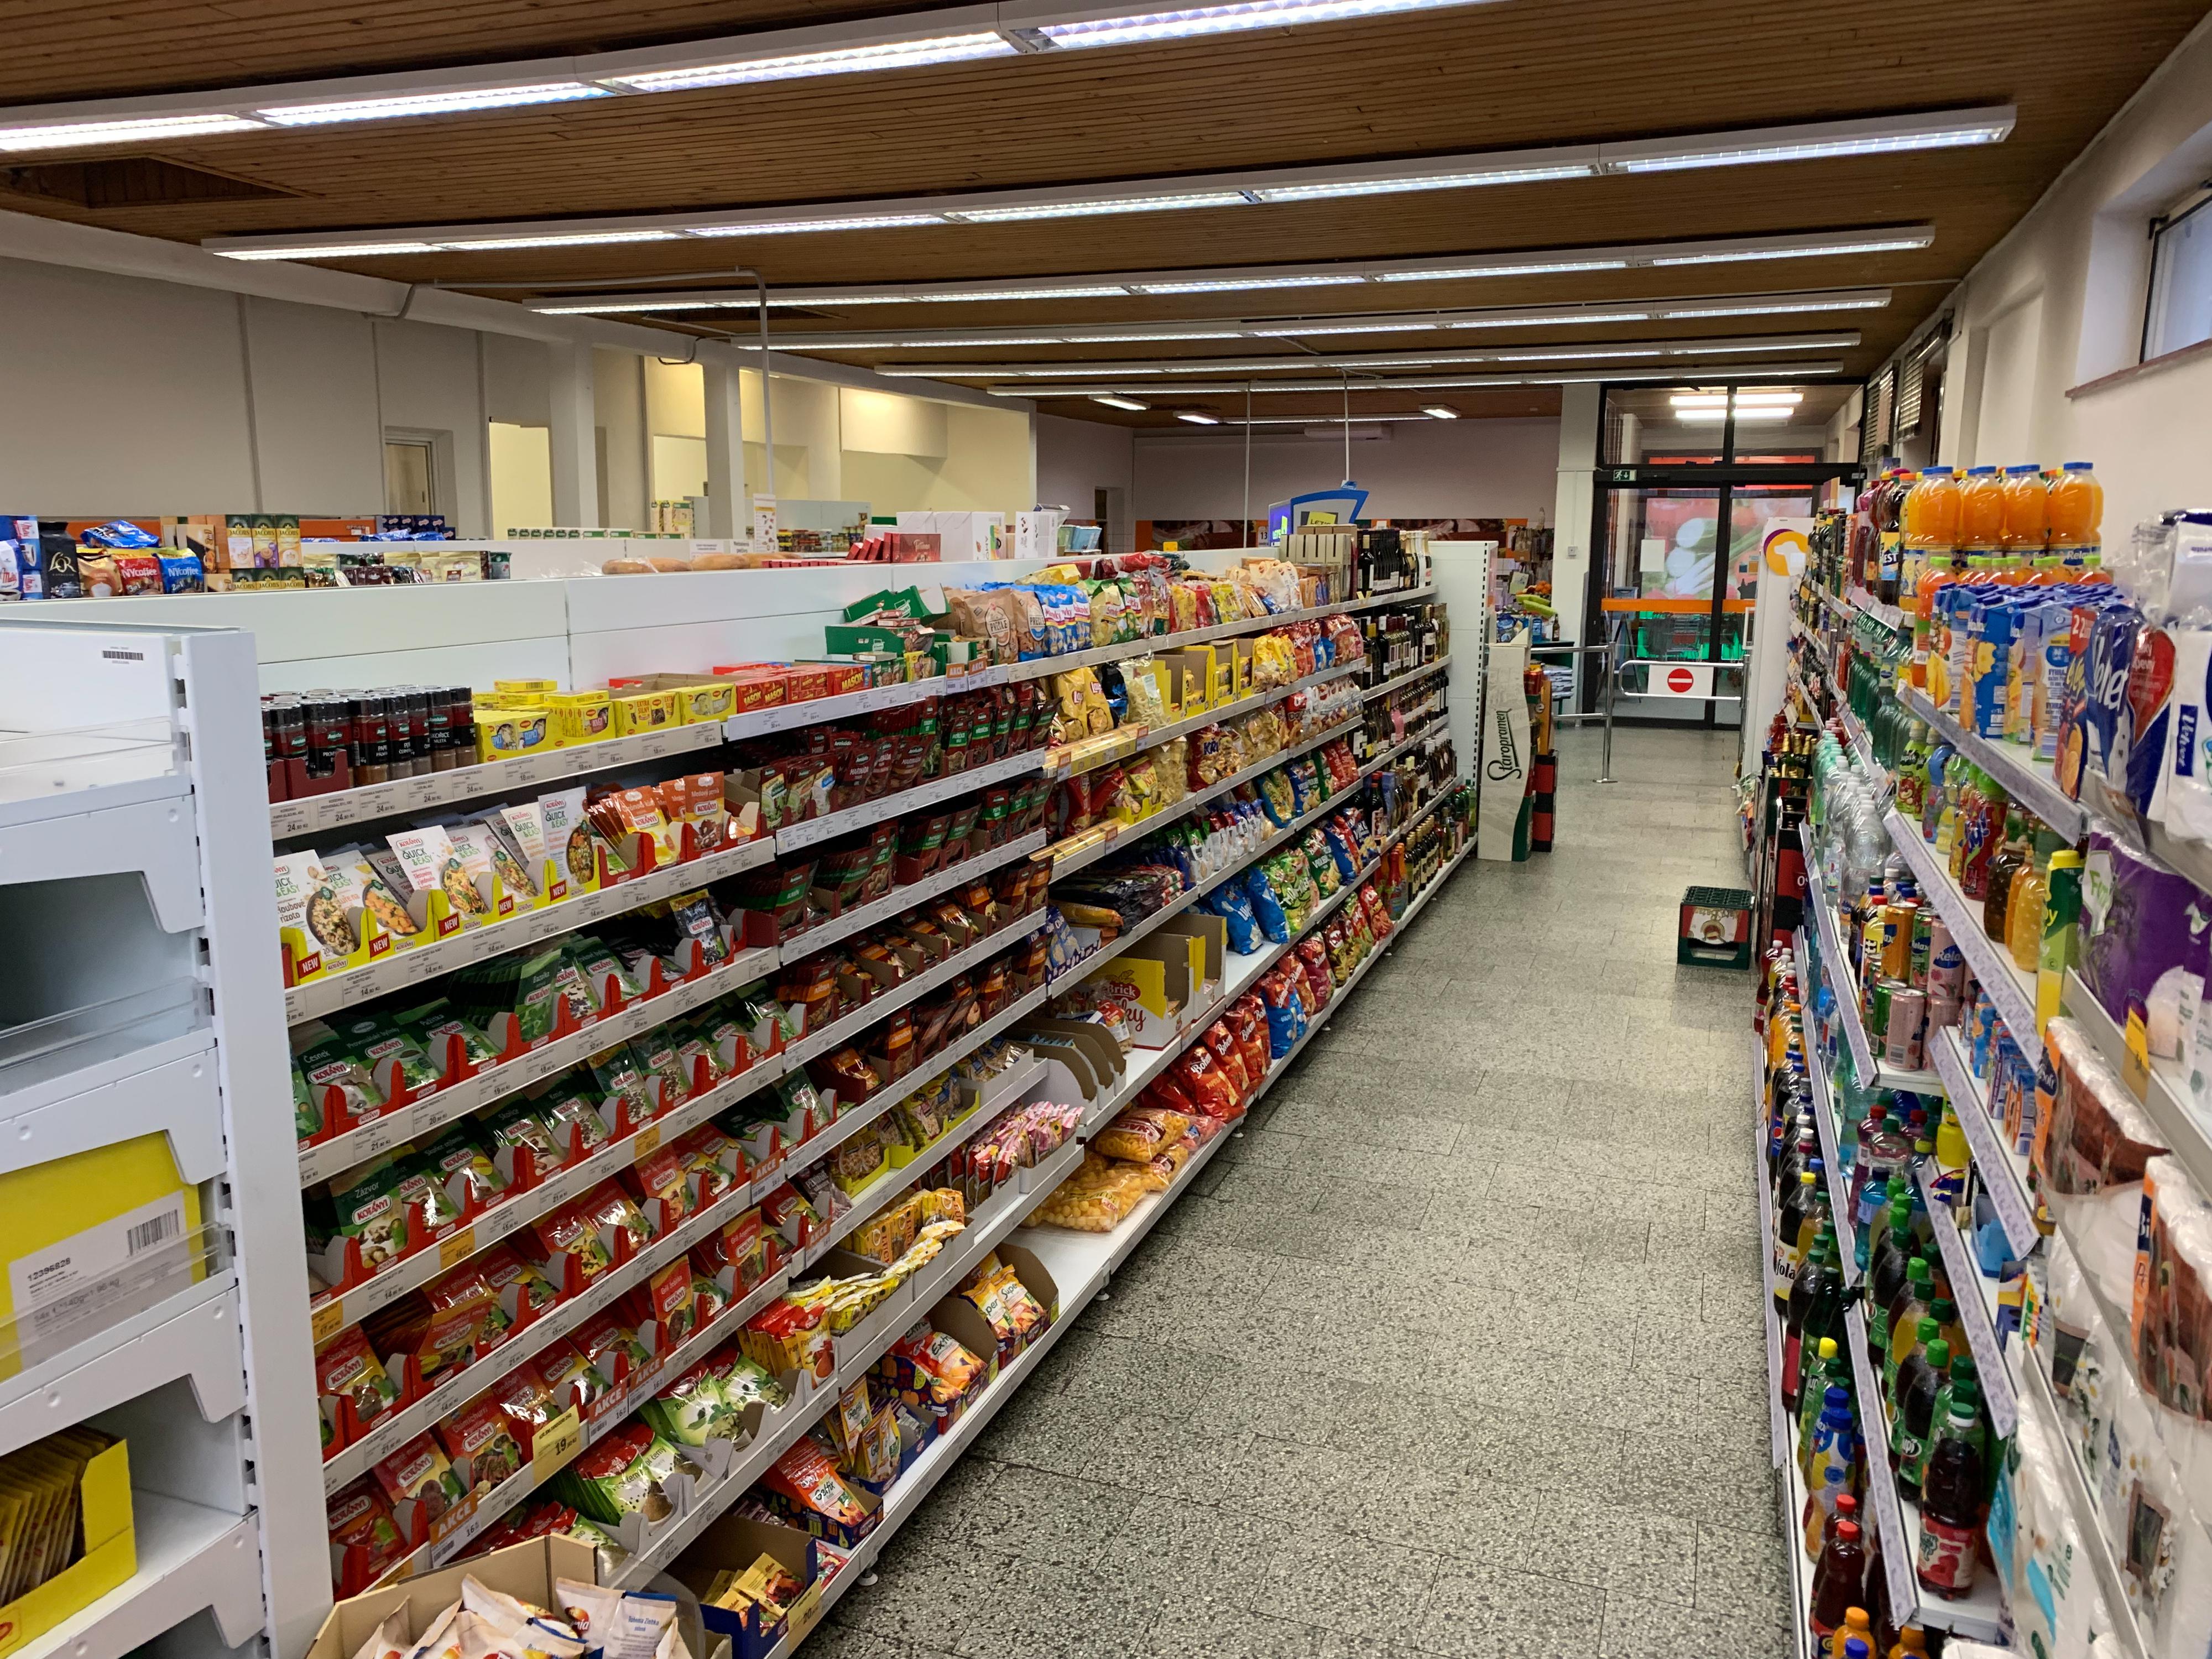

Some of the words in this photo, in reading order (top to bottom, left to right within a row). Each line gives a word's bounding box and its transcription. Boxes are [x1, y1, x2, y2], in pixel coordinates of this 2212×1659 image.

[1261, 531, 1267, 540] 13
[168, 567, 199, 577] NYcoffee
[842, 673, 863, 691] MASOX
[765, 687, 784, 703] MASOX
[1487, 708, 1522, 781] Staropramen
[696, 802, 717, 813] KOTÁNYI
[546, 811, 565, 823] QUICK
[634, 815, 658, 826] KOTÁNYI
[399, 838, 421, 847] KOTÁNYI
[403, 848, 427, 859] QUICK
[553, 884, 566, 896] NEW
[499, 899, 513, 912] NEW
[280, 912, 300, 924] rizoto
[444, 918, 458, 931] NEW
[373, 938, 388, 952] NEW
[1937, 951, 1963, 961] Rela
[302, 958, 319, 973] NEW
[591, 959, 614, 972] KOTÁNYI
[371, 1040, 402, 1056] KOTÁNYI
[680, 1041, 701, 1055] KOTÁNYI
[304, 1050, 331, 1063] Česnek
[651, 1051, 672, 1065] KOTÁNYI
[312, 1062, 347, 1081] KOTÁNYI
[444, 1150, 472, 1167] KOTÁNYI
[653, 1171, 676, 1187] KOTÁNYI
[354, 1181, 379, 1198] Zázvor
[357, 1197, 389, 1220] KOTÁNYI
[666, 1289, 685, 1309] KOTÁNYI
[331, 1360, 361, 1384] KOTÁNYI
[549, 1359, 573, 1378] KOTÁNYI
[636, 1358, 660, 1384] AKCE
[594, 1387, 623, 1416] AKCE
[467, 1426, 493, 1448] KOTÁNYI
[401, 1457, 431, 1482] KOTÁNYI
[815, 1480, 836, 1501] Gelfix
[330, 1498, 367, 1525] KOTÁNYI
[437, 1501, 472, 1537] AKCE
